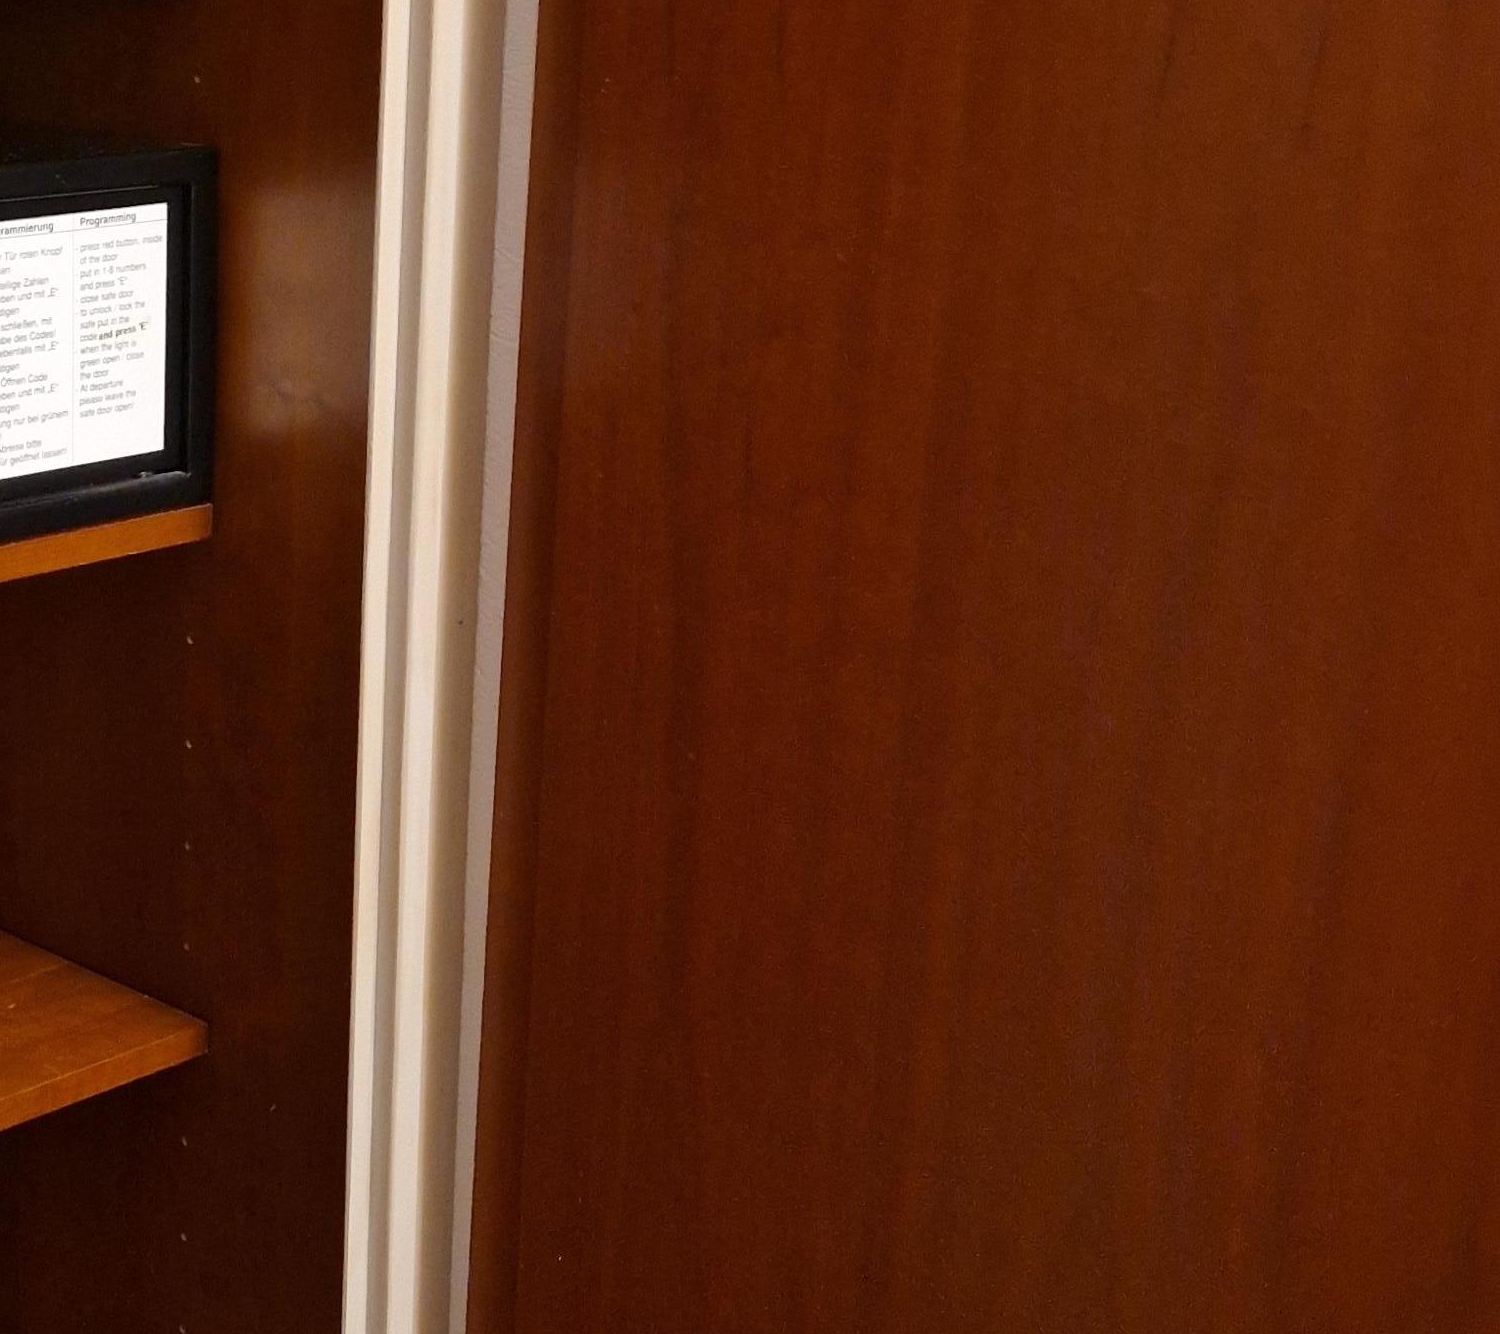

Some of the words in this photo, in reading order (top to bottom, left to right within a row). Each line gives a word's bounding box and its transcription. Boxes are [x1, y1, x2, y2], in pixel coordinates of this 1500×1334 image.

[80, 213, 137, 227] Programming
[4, 251, 17, 261] Tür
[99, 330, 113, 340] and
[115, 326, 137, 338] press
